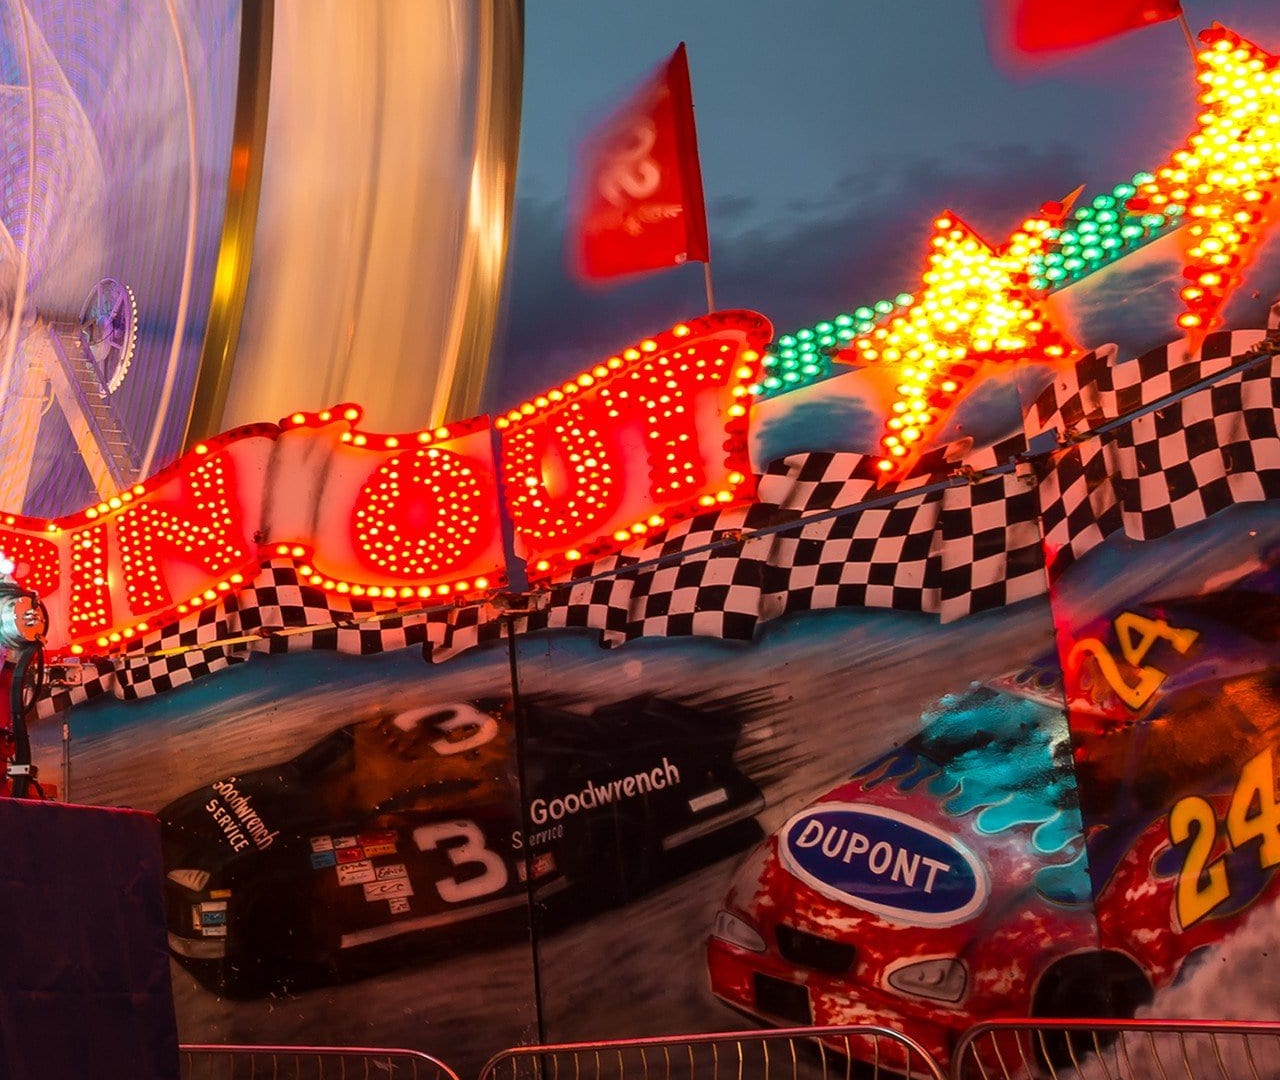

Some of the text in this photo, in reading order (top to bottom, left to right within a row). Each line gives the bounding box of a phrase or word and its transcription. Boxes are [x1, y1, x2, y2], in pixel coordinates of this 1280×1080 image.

[350, 338, 740, 580] OUT
[1061, 611, 1201, 710] 24
[393, 702, 498, 755] 3
[205, 798, 250, 853] SERVICE
[530, 756, 680, 825] Goodwrench
[412, 819, 509, 904] 3
[795, 818, 951, 895] DUPONT
